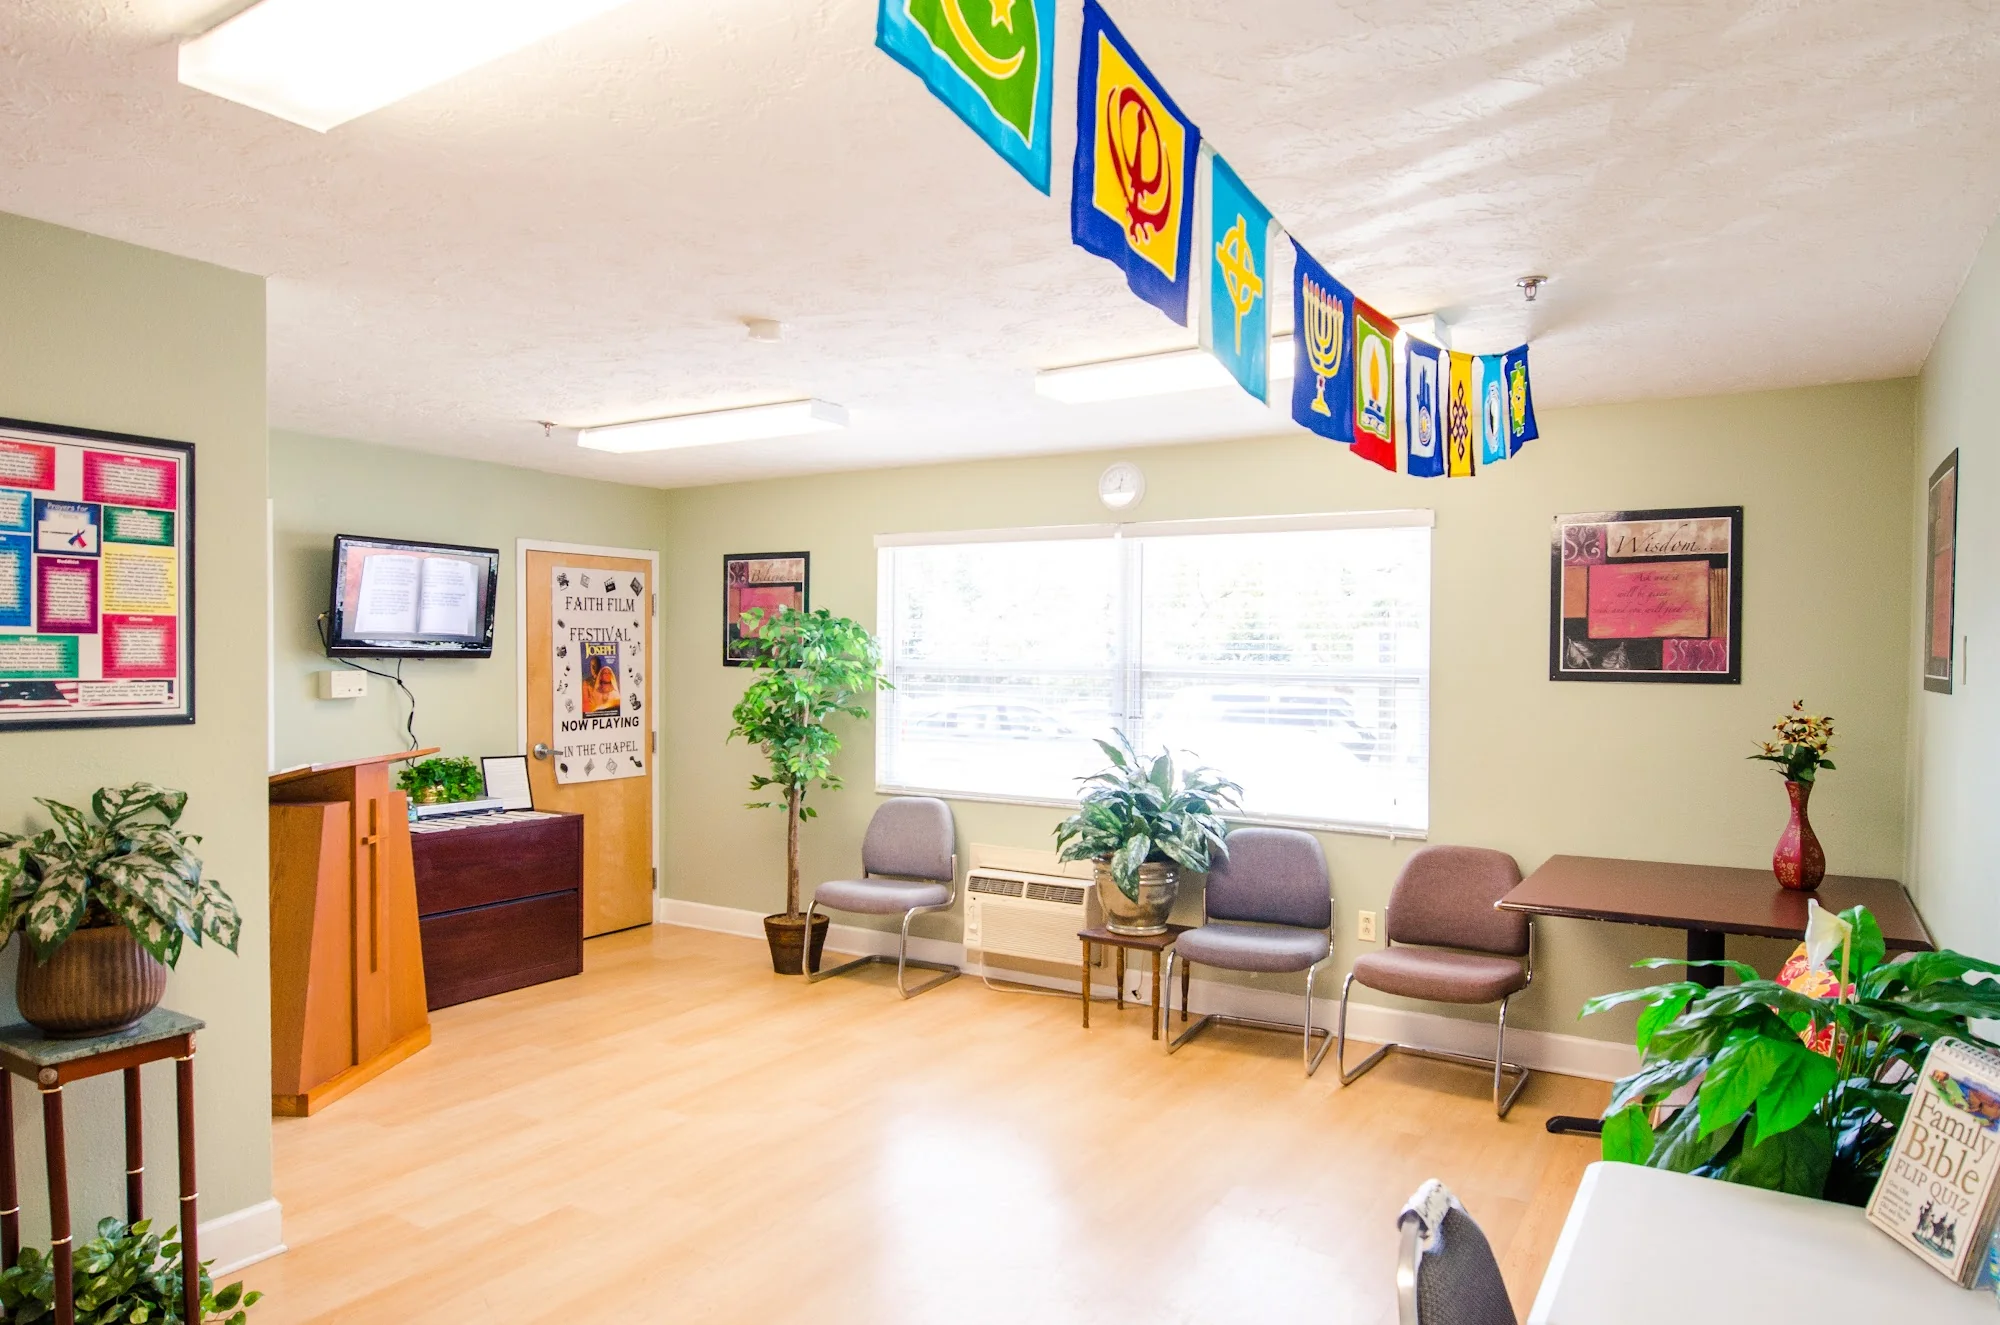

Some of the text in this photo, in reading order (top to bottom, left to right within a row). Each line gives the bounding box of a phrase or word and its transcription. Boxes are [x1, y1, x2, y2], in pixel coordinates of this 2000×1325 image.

[47, 502, 88, 512] Prayers for
[566, 596, 635, 612] FAITH FILM
[570, 625, 631, 641] FESTIVAL
[585, 642, 617, 659] JOSEPH
[561, 716, 640, 732] NOW PLAYING
[564, 740, 638, 758] IN THE CHAPEL
[1915, 1090, 1995, 1163] Family
[1901, 1120, 1980, 1195] Bible
[1894, 1158, 1970, 1216] FLIP QUIZ
